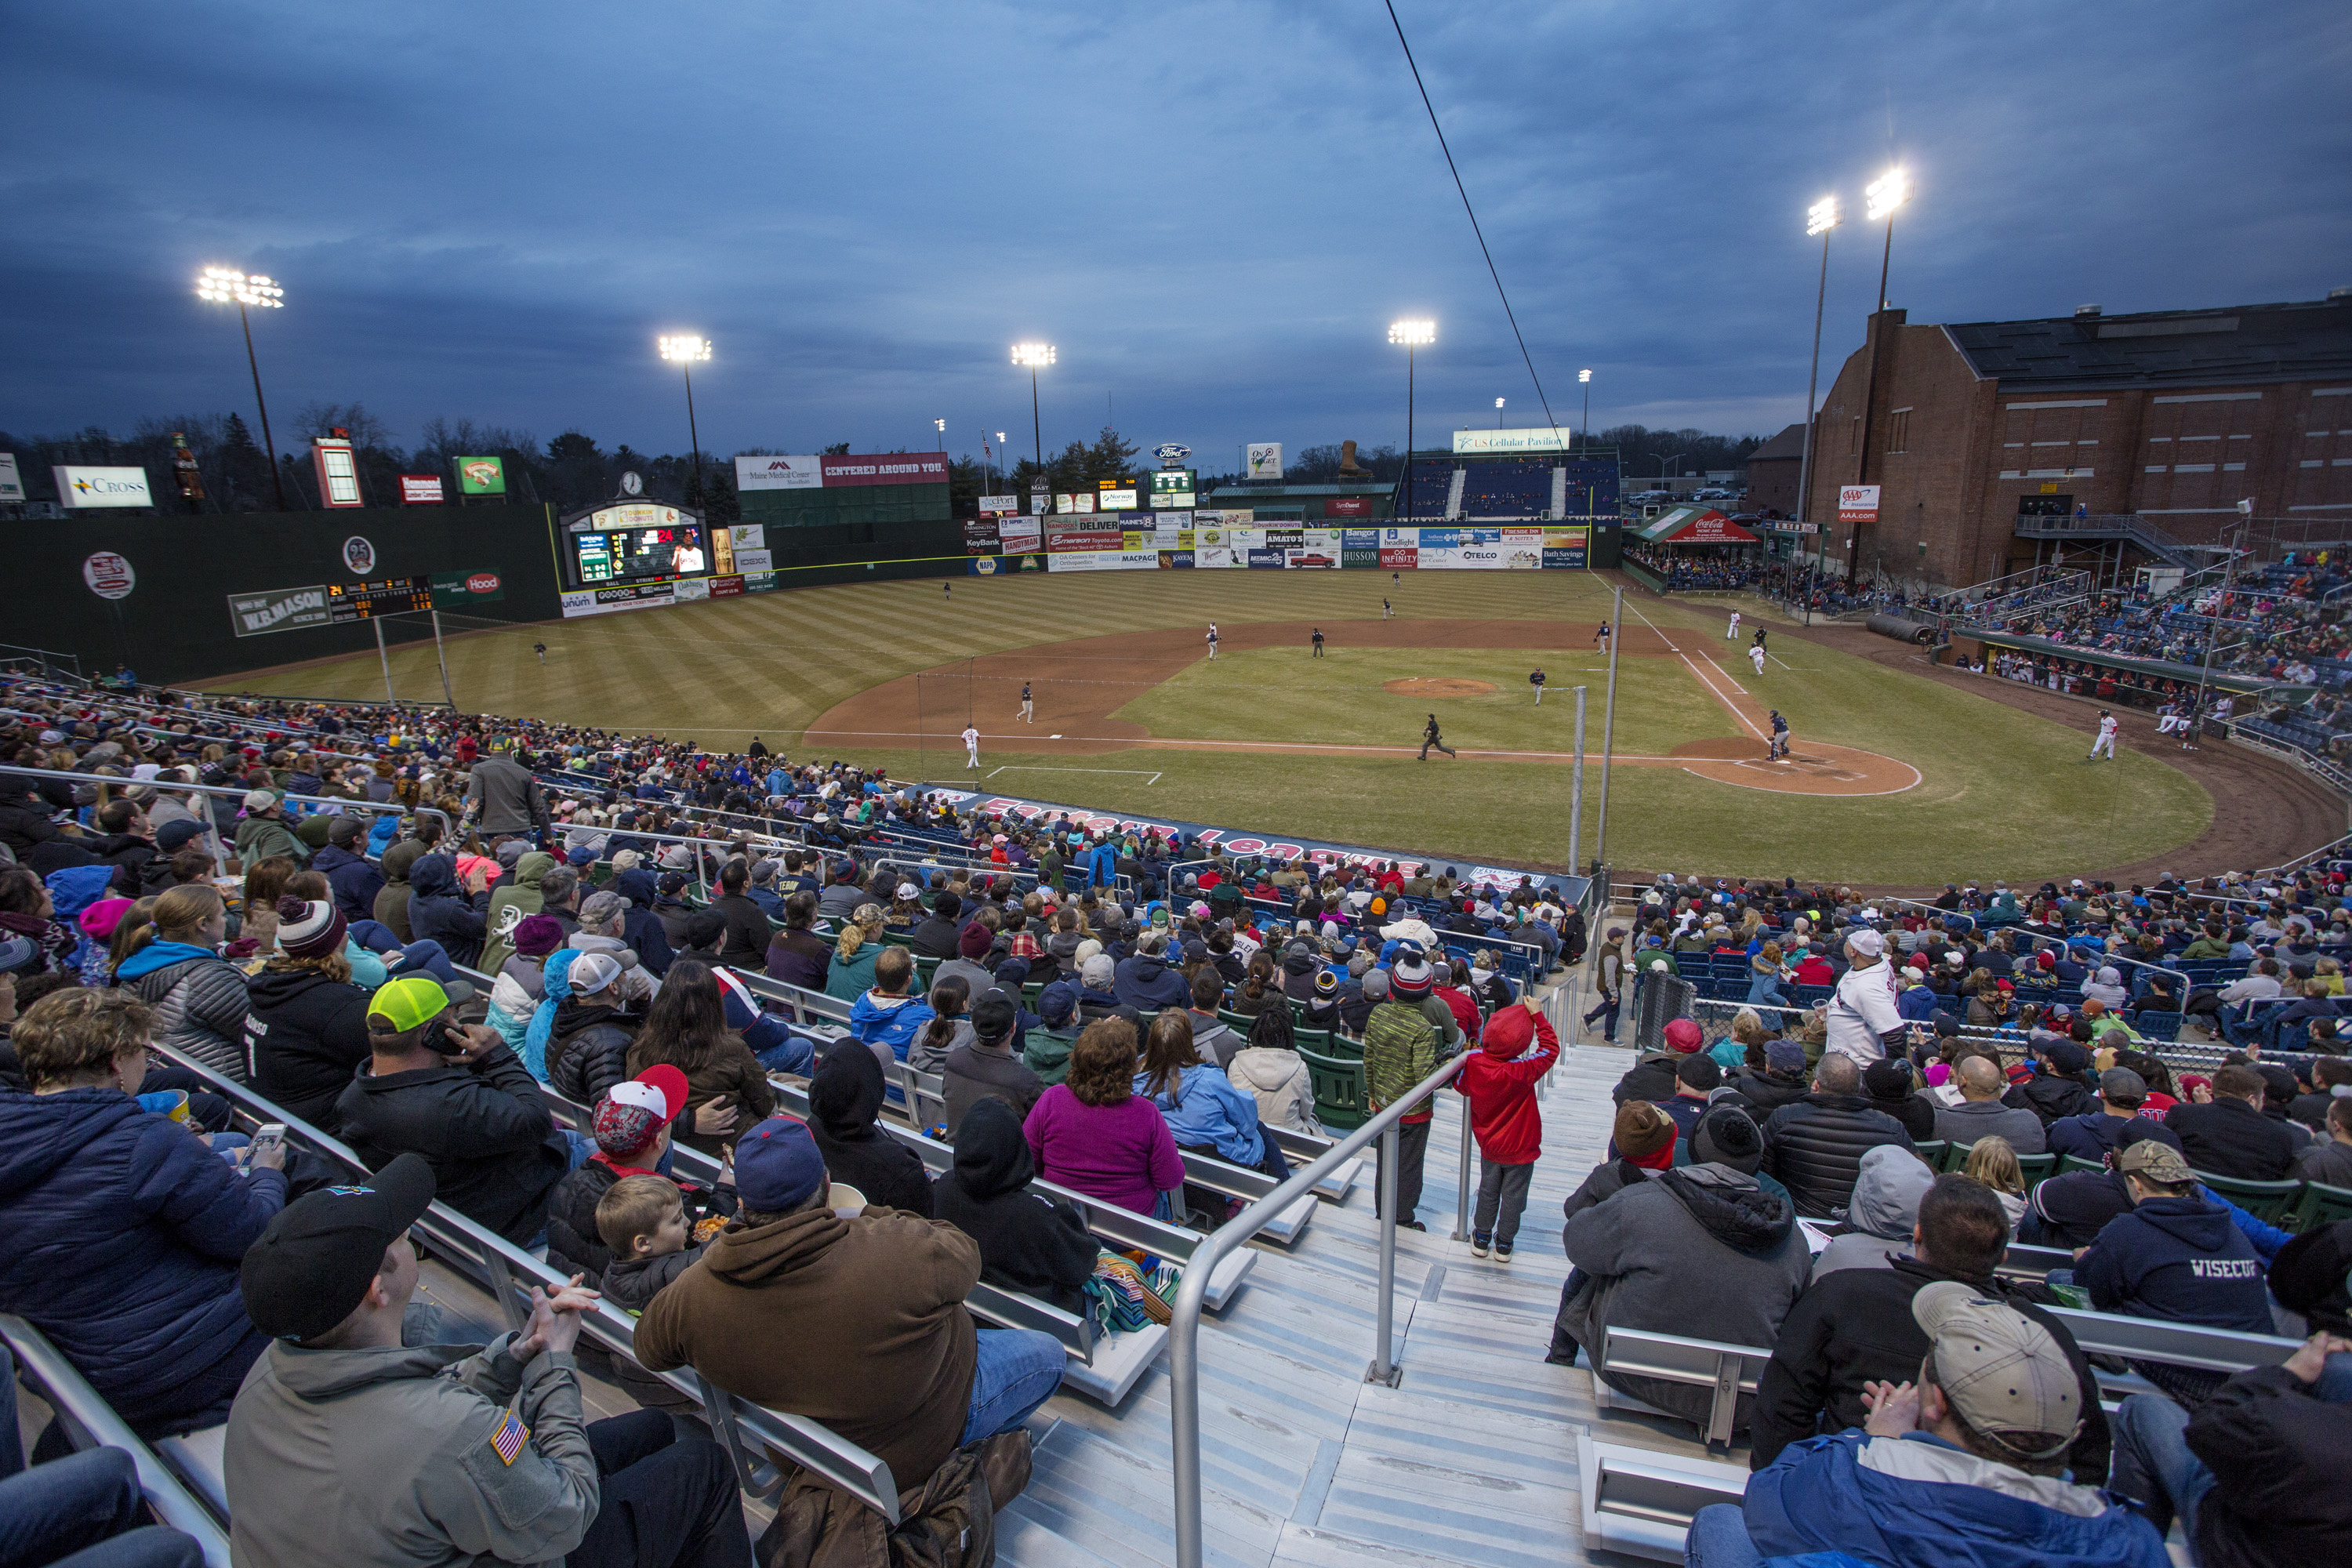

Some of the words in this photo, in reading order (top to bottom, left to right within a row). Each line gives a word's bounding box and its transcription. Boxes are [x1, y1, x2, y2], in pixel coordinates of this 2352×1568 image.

[1475, 439, 1489, 448] U.S.
[1490, 438, 1524, 447] Cellular
[1528, 437, 1562, 446] Pavilion
[1160, 447, 1189, 457] Ford
[825, 465, 877, 476] CENTERED
[879, 463, 920, 474] AROUND
[921, 463, 945, 472] YOU.
[1844, 490, 1860, 501] AAA
[992, 496, 1014, 506] cPort
[1080, 521, 1119, 531] DELIVER
[657, 529, 674, 543] 24
[1346, 528, 1377, 538] Bangor
[967, 539, 1000, 548] KeyBank
[1004, 535, 1039, 551] HANDYMAN
[1050, 535, 1091, 546] Emerson
[1384, 539, 1415, 547] headlight
[1173, 554, 1194, 563] KAYEM
[1272, 553, 1283, 565] 25
[1344, 551, 1377, 561] HUSSON
[1559, 550, 1584, 559] Savings
[740, 557, 768, 565] IDEXX
[979, 561, 994, 570] NAPA
[470, 577, 498, 590] Hood
[678, 579, 704, 591] Oakhurst
[329, 585, 343, 596] 24
[562, 598, 590, 608] unum
